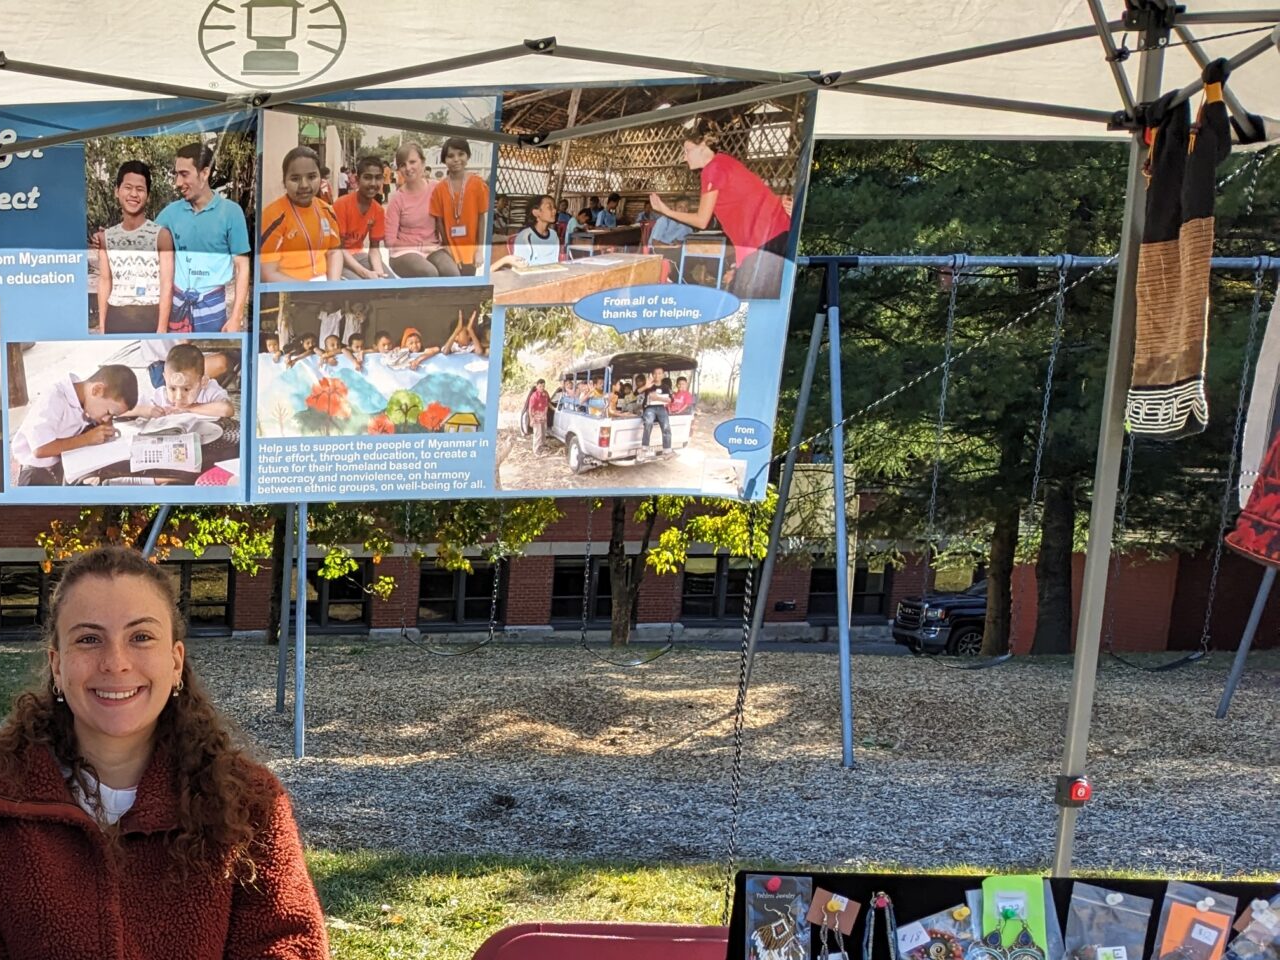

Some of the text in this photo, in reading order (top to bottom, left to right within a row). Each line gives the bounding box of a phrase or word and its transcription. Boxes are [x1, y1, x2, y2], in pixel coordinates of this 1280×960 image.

[19, 252, 83, 268] Myanmar
[6, 271, 75, 285] education
[603, 295, 677, 306] From all of us,
[602, 307, 702, 320] thanks for helping.
[734, 425, 754, 434] from
[258, 438, 489, 456] Help us to support the people of Myanmar in
[728, 436, 758, 446] me too
[258, 448, 477, 464] their effort, through education, to create a
[258, 460, 437, 474] future for their homeland based on
[257, 470, 471, 486] democracy and nonviolence, on harmony
[257, 479, 487, 494] between ethnic groups, on well-being for all.
